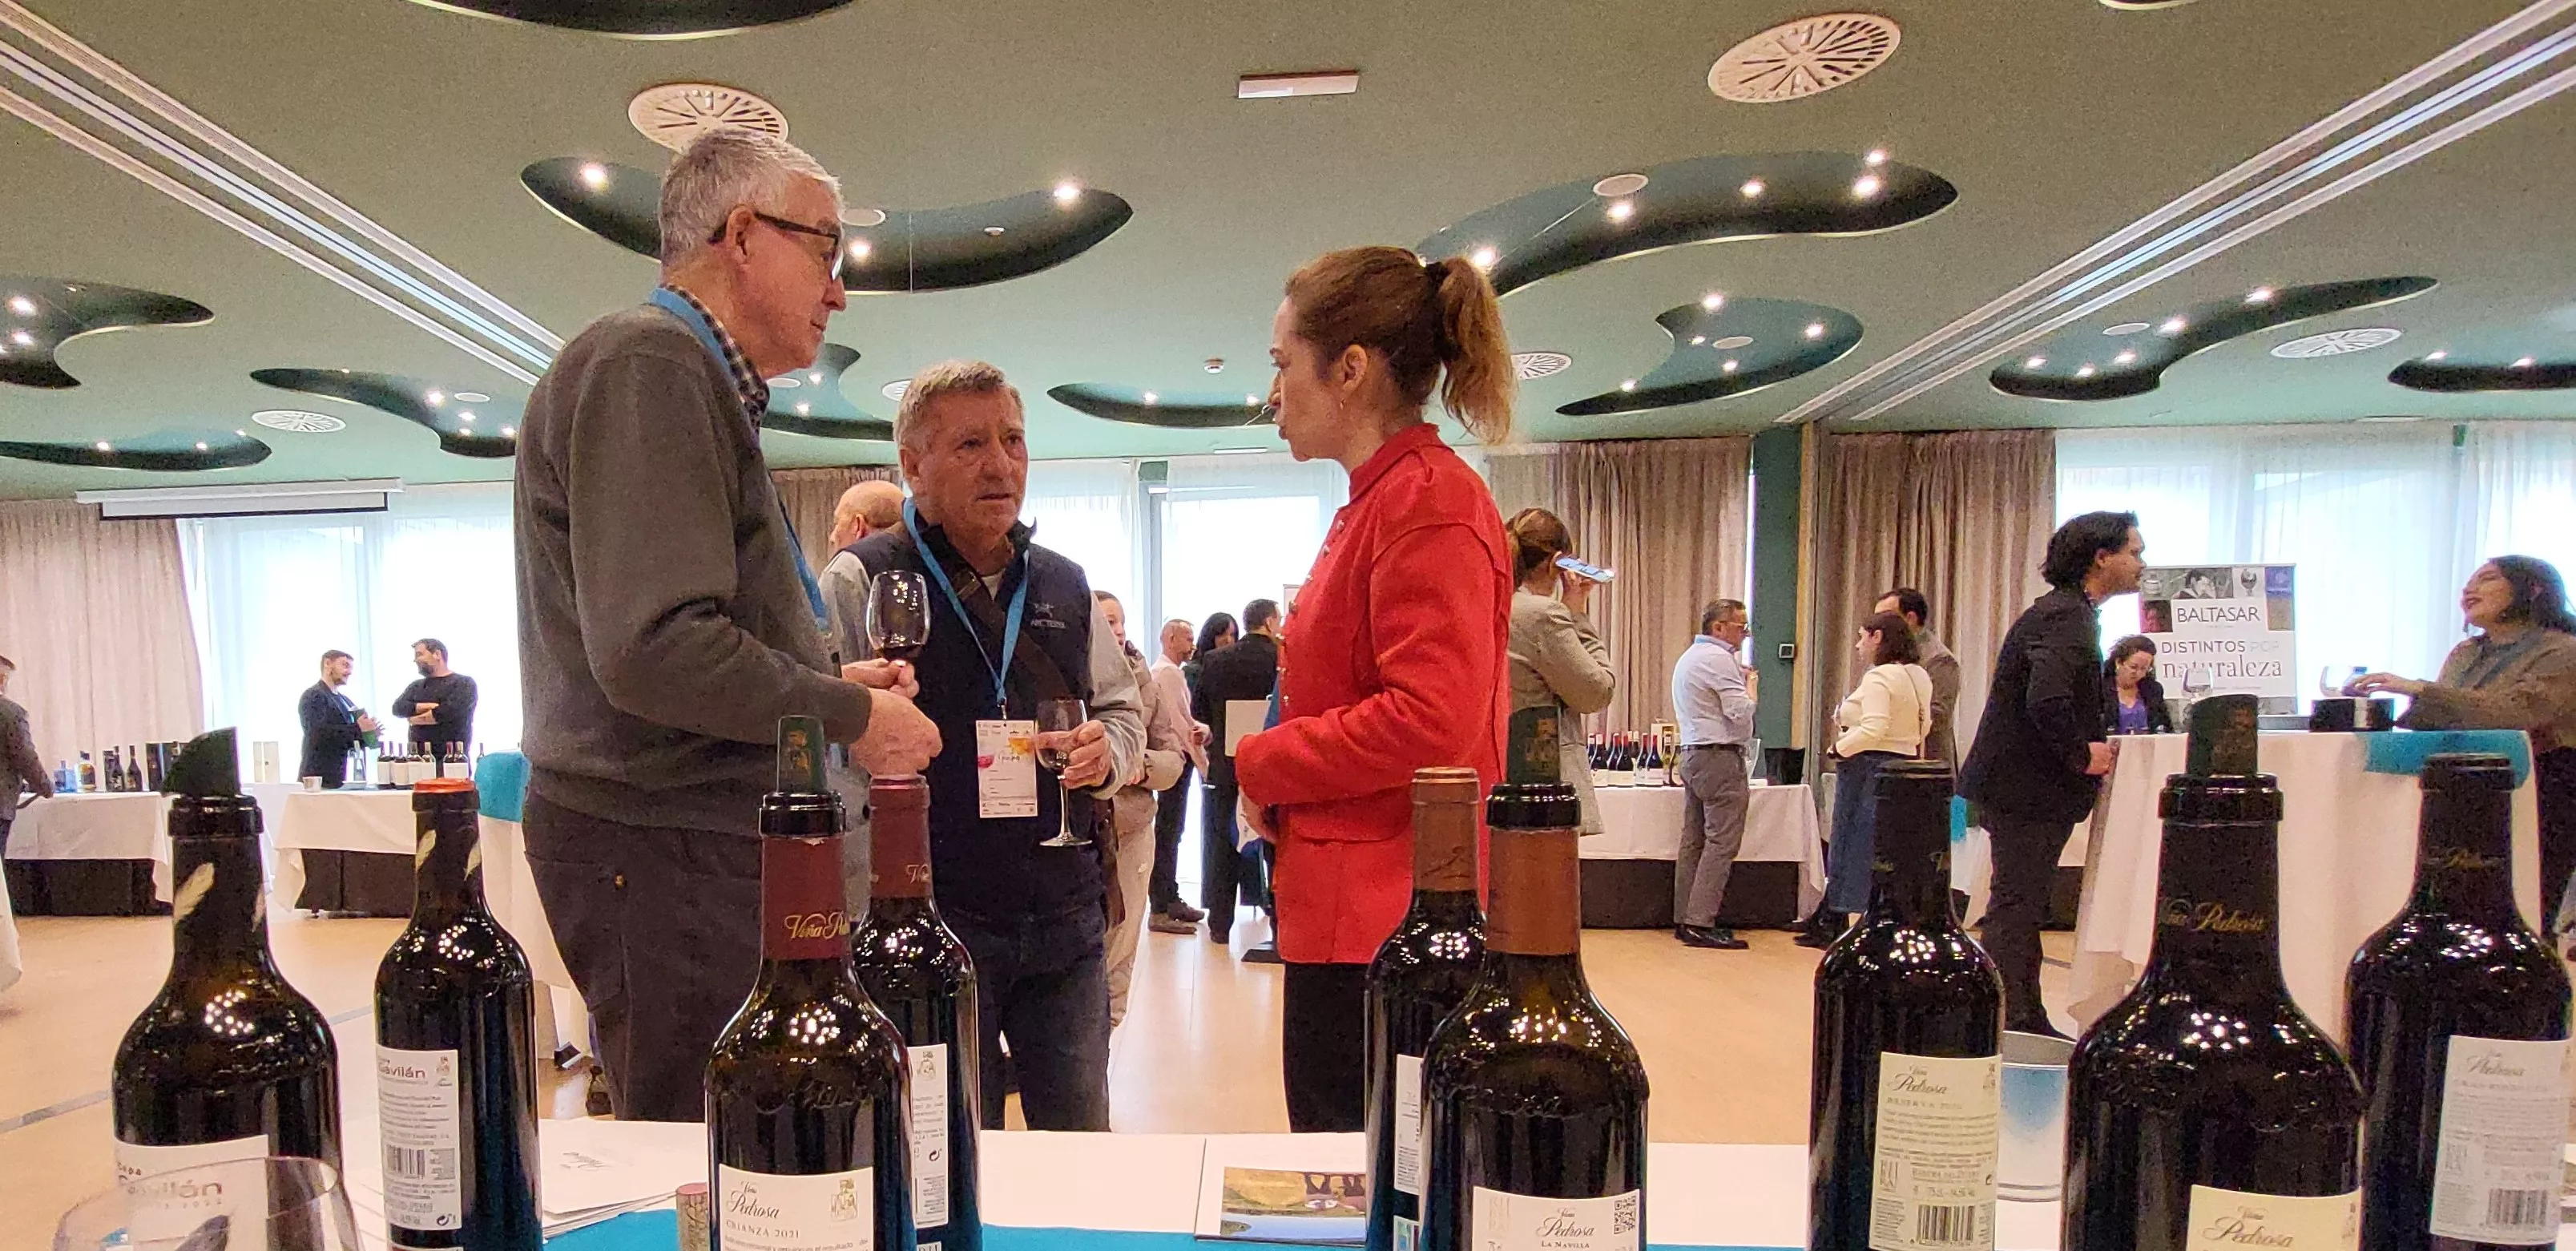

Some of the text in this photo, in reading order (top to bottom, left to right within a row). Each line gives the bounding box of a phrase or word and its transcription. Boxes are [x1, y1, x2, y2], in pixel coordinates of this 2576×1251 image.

[2177, 607, 2260, 623] BALTASAR
[2162, 641, 2245, 654] DISTINTOS
[1886, 1072, 1948, 1094] Pedrosa
[726, 1190, 780, 1220] Pedrosa
[726, 1218, 799, 1239] CRIANZA 2021
[1536, 1217, 1595, 1237] Pedrosa
[2202, 1216, 2294, 1248] Pedrosa
[1541, 1240, 1590, 1249] LA NAVILLA
